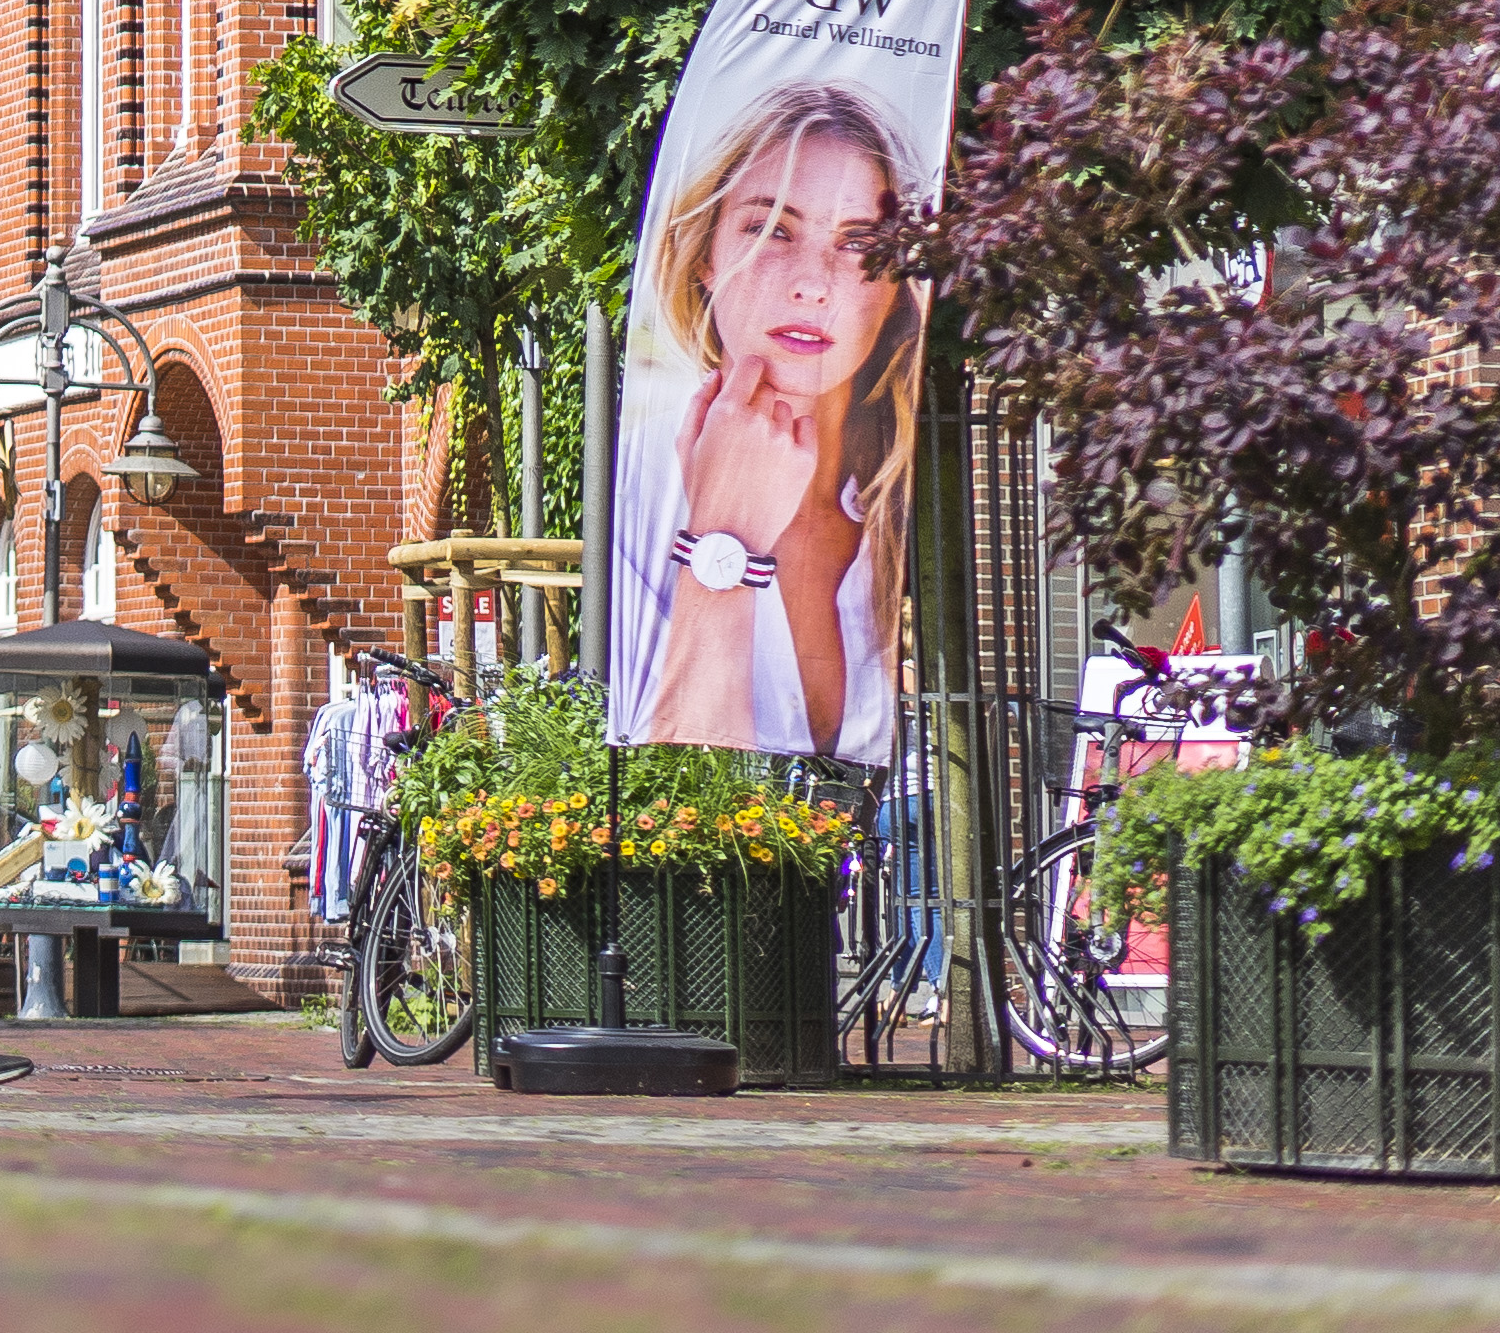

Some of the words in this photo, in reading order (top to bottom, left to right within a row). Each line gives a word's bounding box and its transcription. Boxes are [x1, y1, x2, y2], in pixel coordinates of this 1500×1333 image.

[750, 13, 820, 40] Daniel
[827, 22, 941, 58] Wellington
[442, 595, 490, 614] SE
